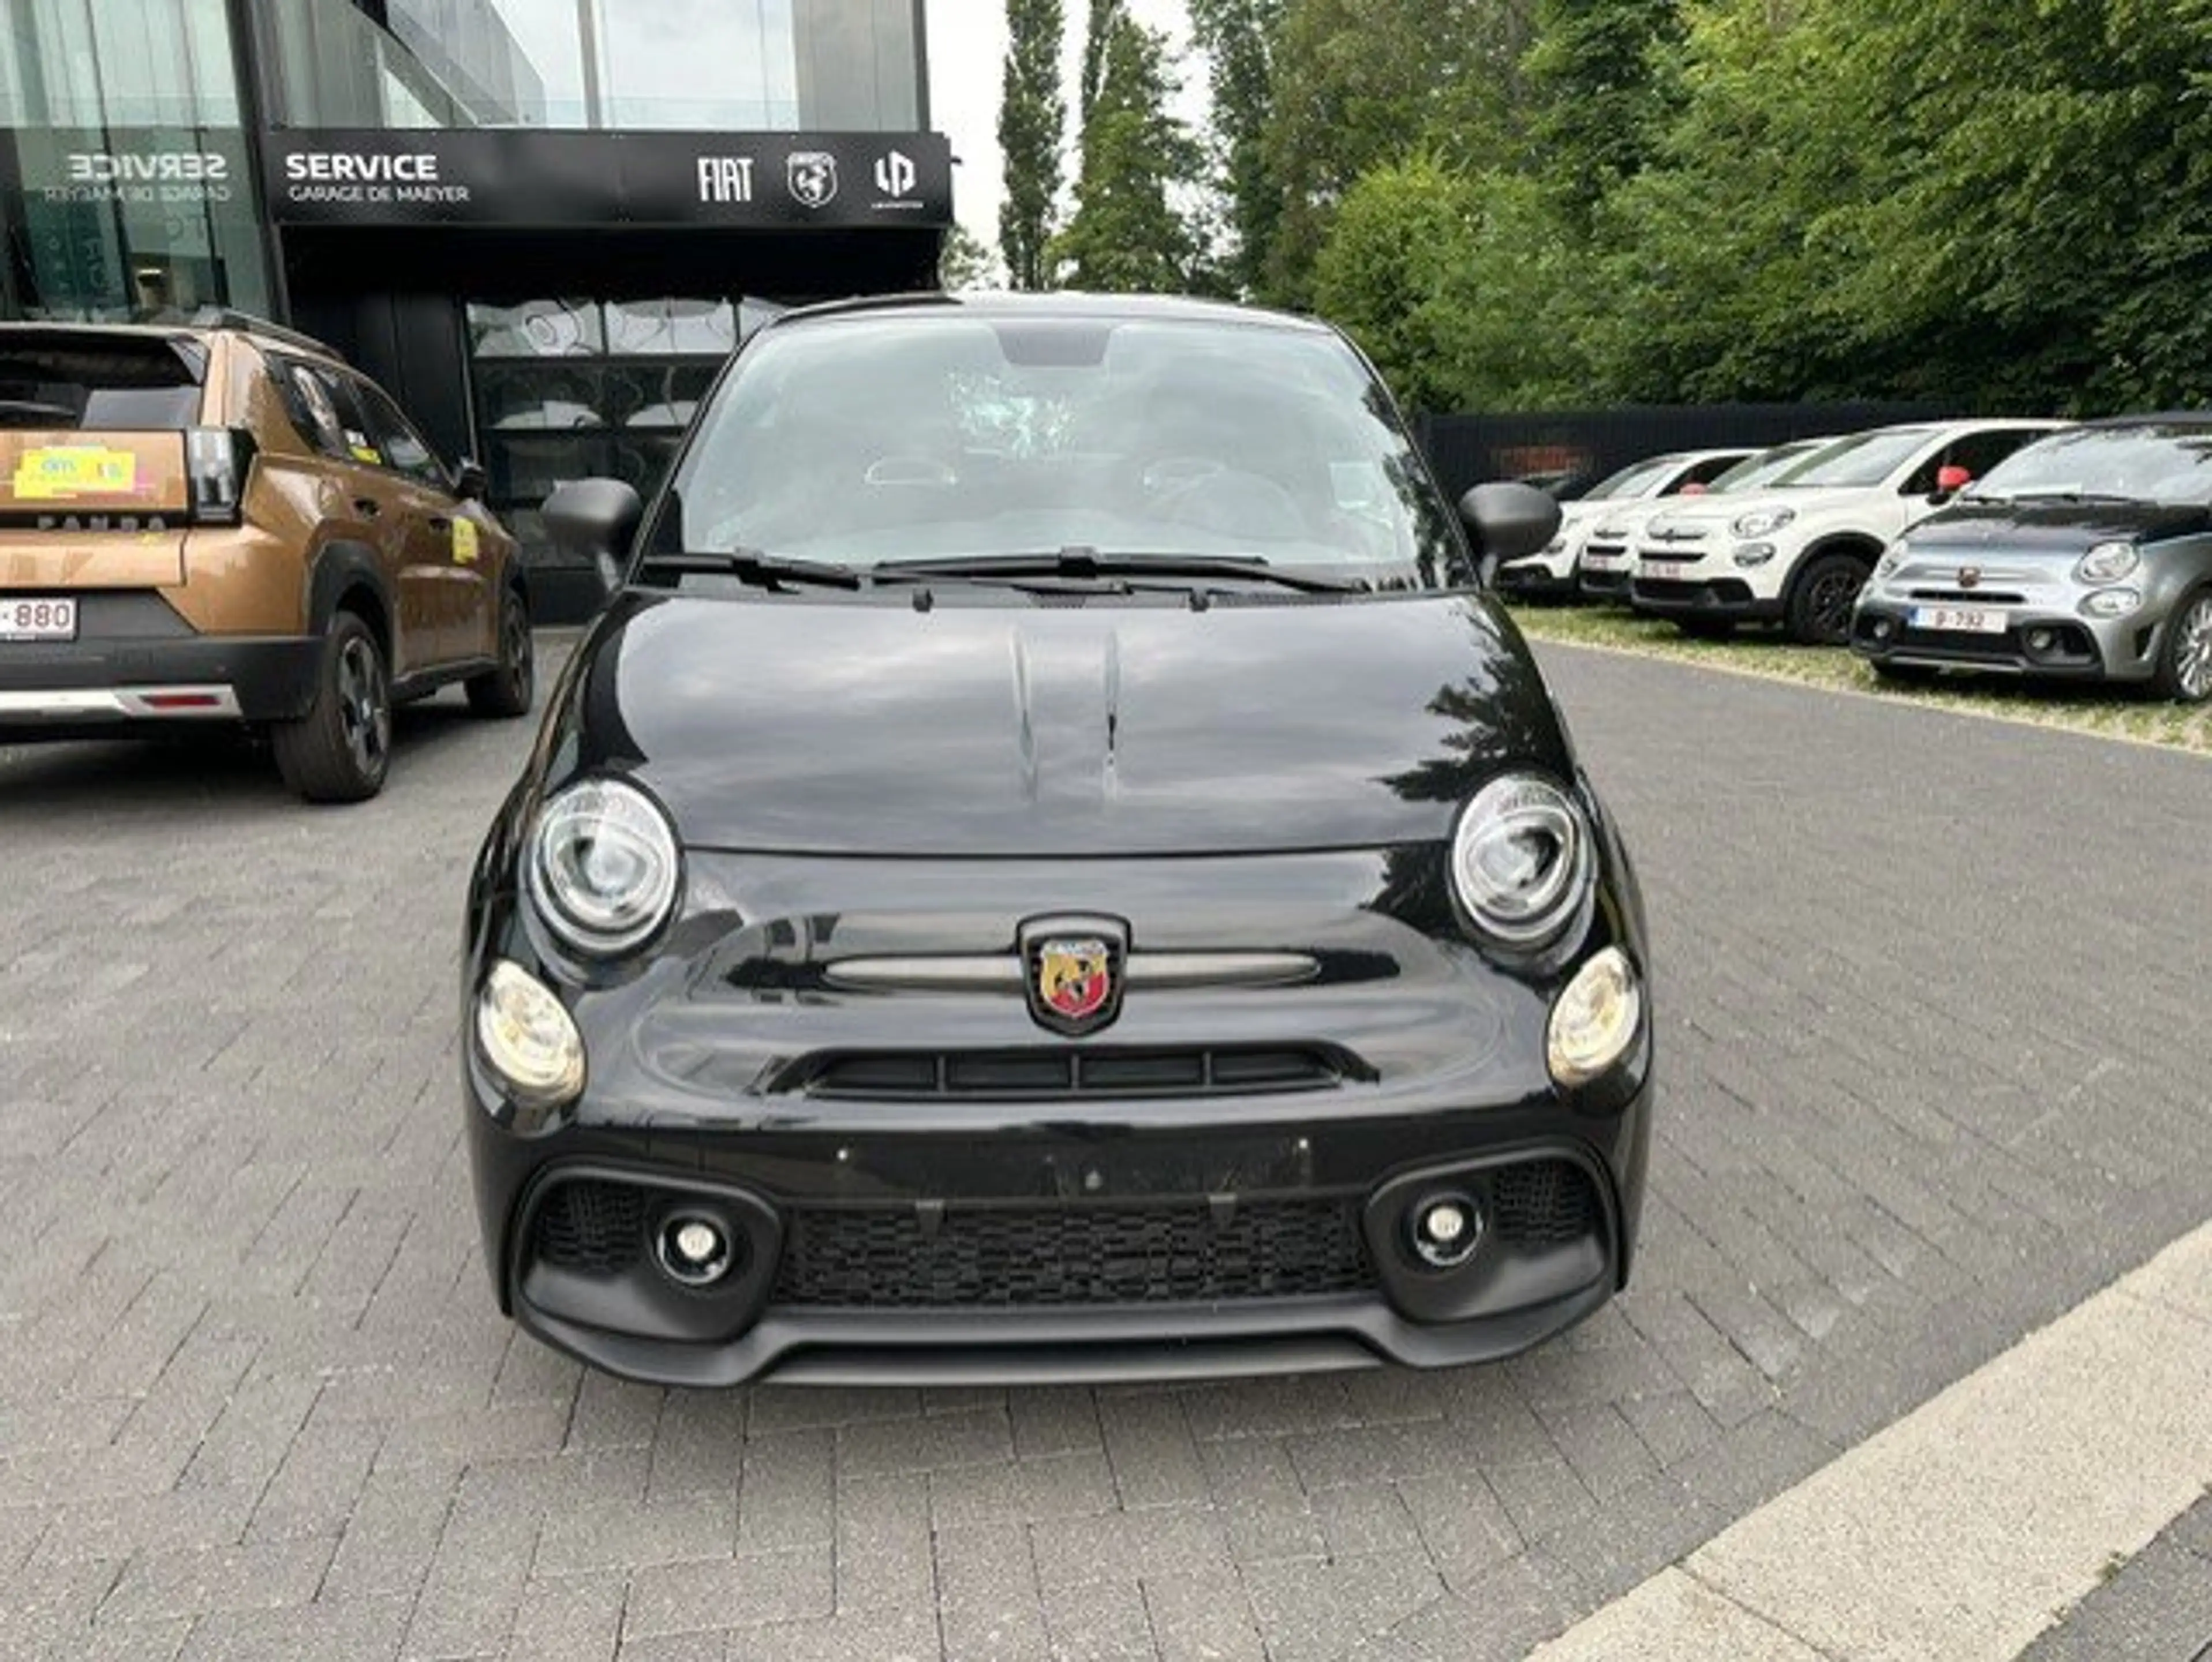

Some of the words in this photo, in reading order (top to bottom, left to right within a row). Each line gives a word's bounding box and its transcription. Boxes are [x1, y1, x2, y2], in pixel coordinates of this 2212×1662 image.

[286, 154, 439, 180] SERVICE
[697, 158, 753, 202] FIAT
[289, 185, 364, 202] GARAGE
[367, 185, 395, 202] DE
